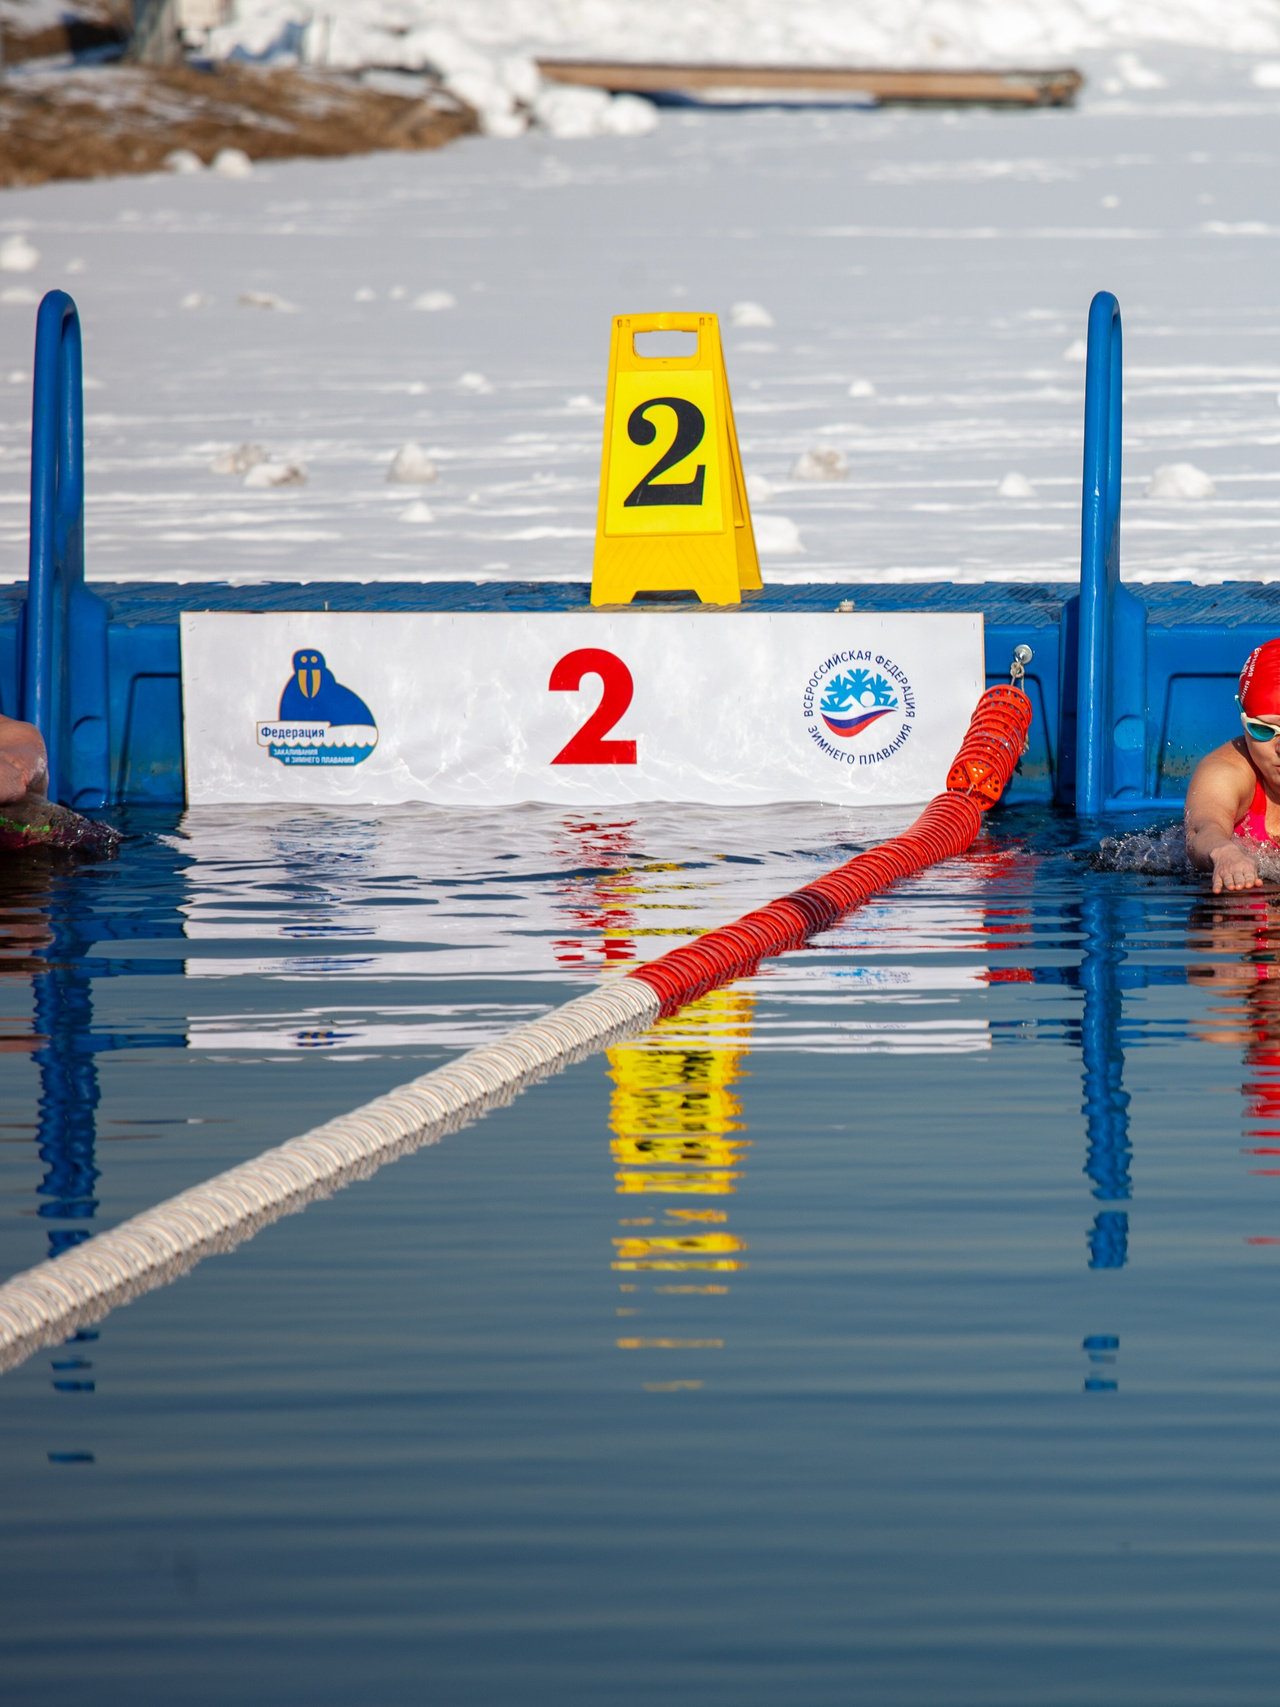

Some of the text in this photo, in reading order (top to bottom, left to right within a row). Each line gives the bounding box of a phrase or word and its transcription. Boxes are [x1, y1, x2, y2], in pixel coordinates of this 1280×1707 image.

[623, 397, 706, 507] 2
[548, 648, 637, 764] 2
[803, 650, 916, 718] ВСЕРОССИЙСКАЯ ФЕДЕРАЦИЯ
[261, 727, 324, 740] Федерация
[274, 748, 318, 756] ЗАКАЛИВАНИЯ
[808, 724, 912, 765] ЗИМНЕГО ПЛАВАНИЯ
